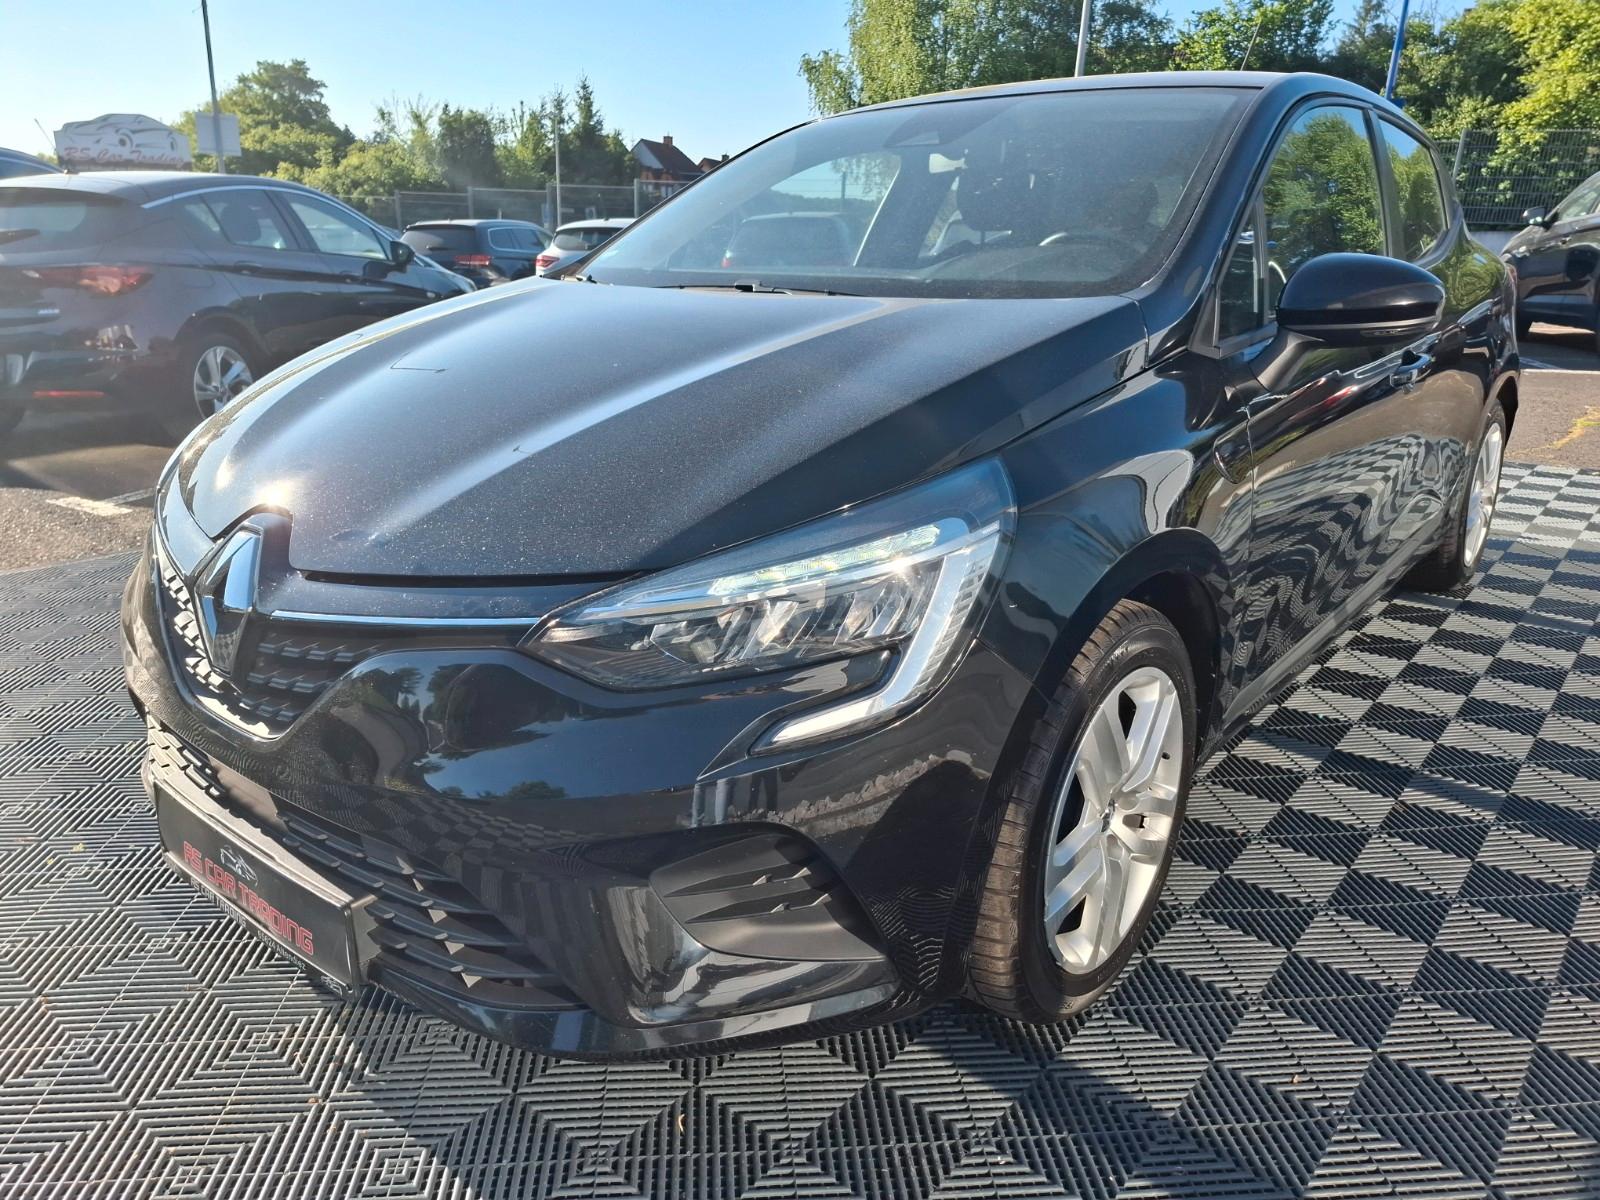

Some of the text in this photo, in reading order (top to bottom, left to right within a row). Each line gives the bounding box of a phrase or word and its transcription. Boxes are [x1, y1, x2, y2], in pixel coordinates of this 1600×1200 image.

[96, 149, 123, 163] Car
[130, 150, 185, 167] Trading
[183, 841, 314, 955] RS CAR TRADING
[201, 886, 215, 903] CAR
[216, 897, 247, 928] TRADING
